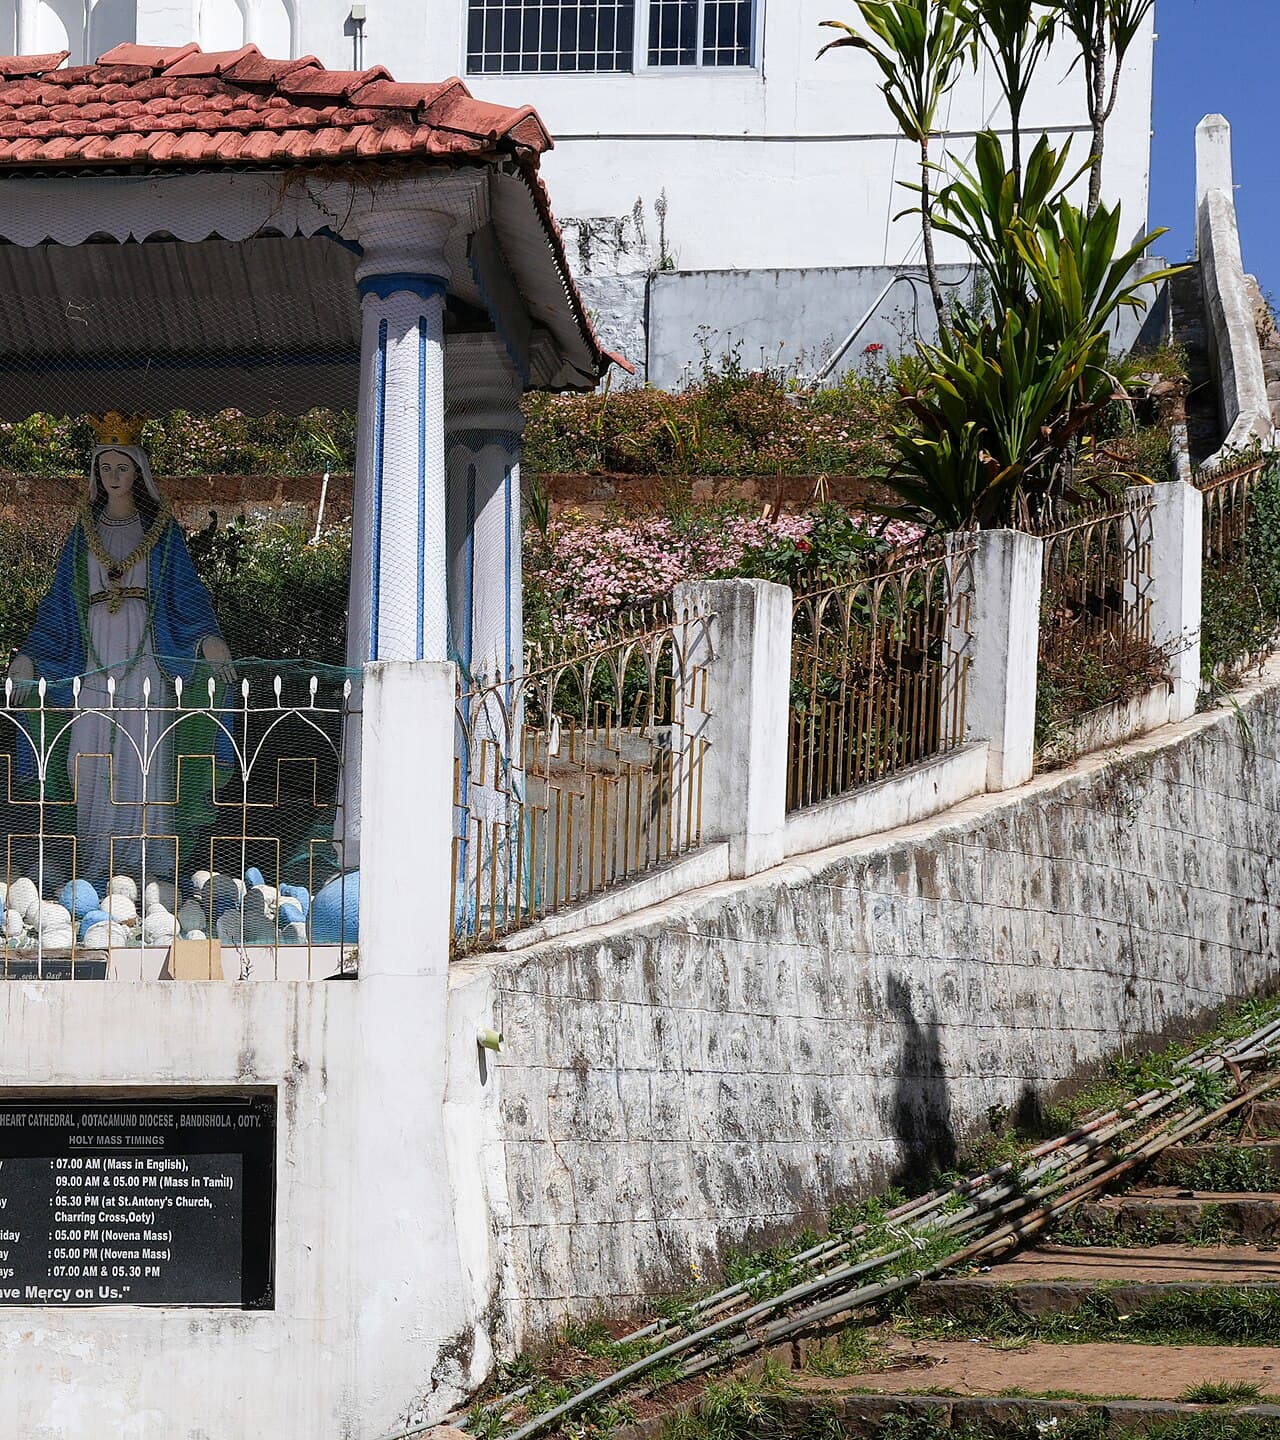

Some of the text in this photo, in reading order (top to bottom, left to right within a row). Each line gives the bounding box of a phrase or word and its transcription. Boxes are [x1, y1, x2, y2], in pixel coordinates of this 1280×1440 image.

[0, 1114, 26, 1126] HEART
[82, 1114, 137, 1126] OOTACAMUND
[238, 1115, 261, 1127] OOTY.
[69, 1136, 164, 1144] HOLY MASS TIMINGS
[57, 1159, 82, 1169] 07.00
[85, 1159, 100, 1169] AM
[103, 1159, 132, 1171] (Mass
[135, 1159, 143, 1169] in
[147, 1159, 188, 1172] English),
[56, 1176, 233, 1190] 09.00 AM & 05.00 PM (Mass in Tamil)
[56, 1196, 81, 1206] 05.30
[85, 1196, 99, 1206] PM
[102, 1196, 115, 1208] (at
[118, 1196, 173, 1209] St.Antony's
[176, 1196, 212, 1208] Church,
[55, 1212, 154, 1224] Charring Cross,Ooty)
[55, 1230, 81, 1240] 05.00
[84, 1230, 98, 1240] PM
[102, 1230, 140, 1242] (Novena
[144, 1230, 172, 1242] Mass)
[54, 1248, 80, 1259] 05.00
[83, 1248, 97, 1258] PM
[101, 1248, 139, 1261] (Novena
[142, 1248, 170, 1261] Mass)
[54, 1266, 80, 1276] 07.00
[82, 1266, 97, 1276] AM
[101, 1266, 108, 1276] &
[112, 1266, 141, 1277] 05.30
[145, 1267, 160, 1277] PM
[25, 1286, 71, 1302] Mercy
[76, 1289, 93, 1298] on
[99, 1286, 130, 1298] Us."
